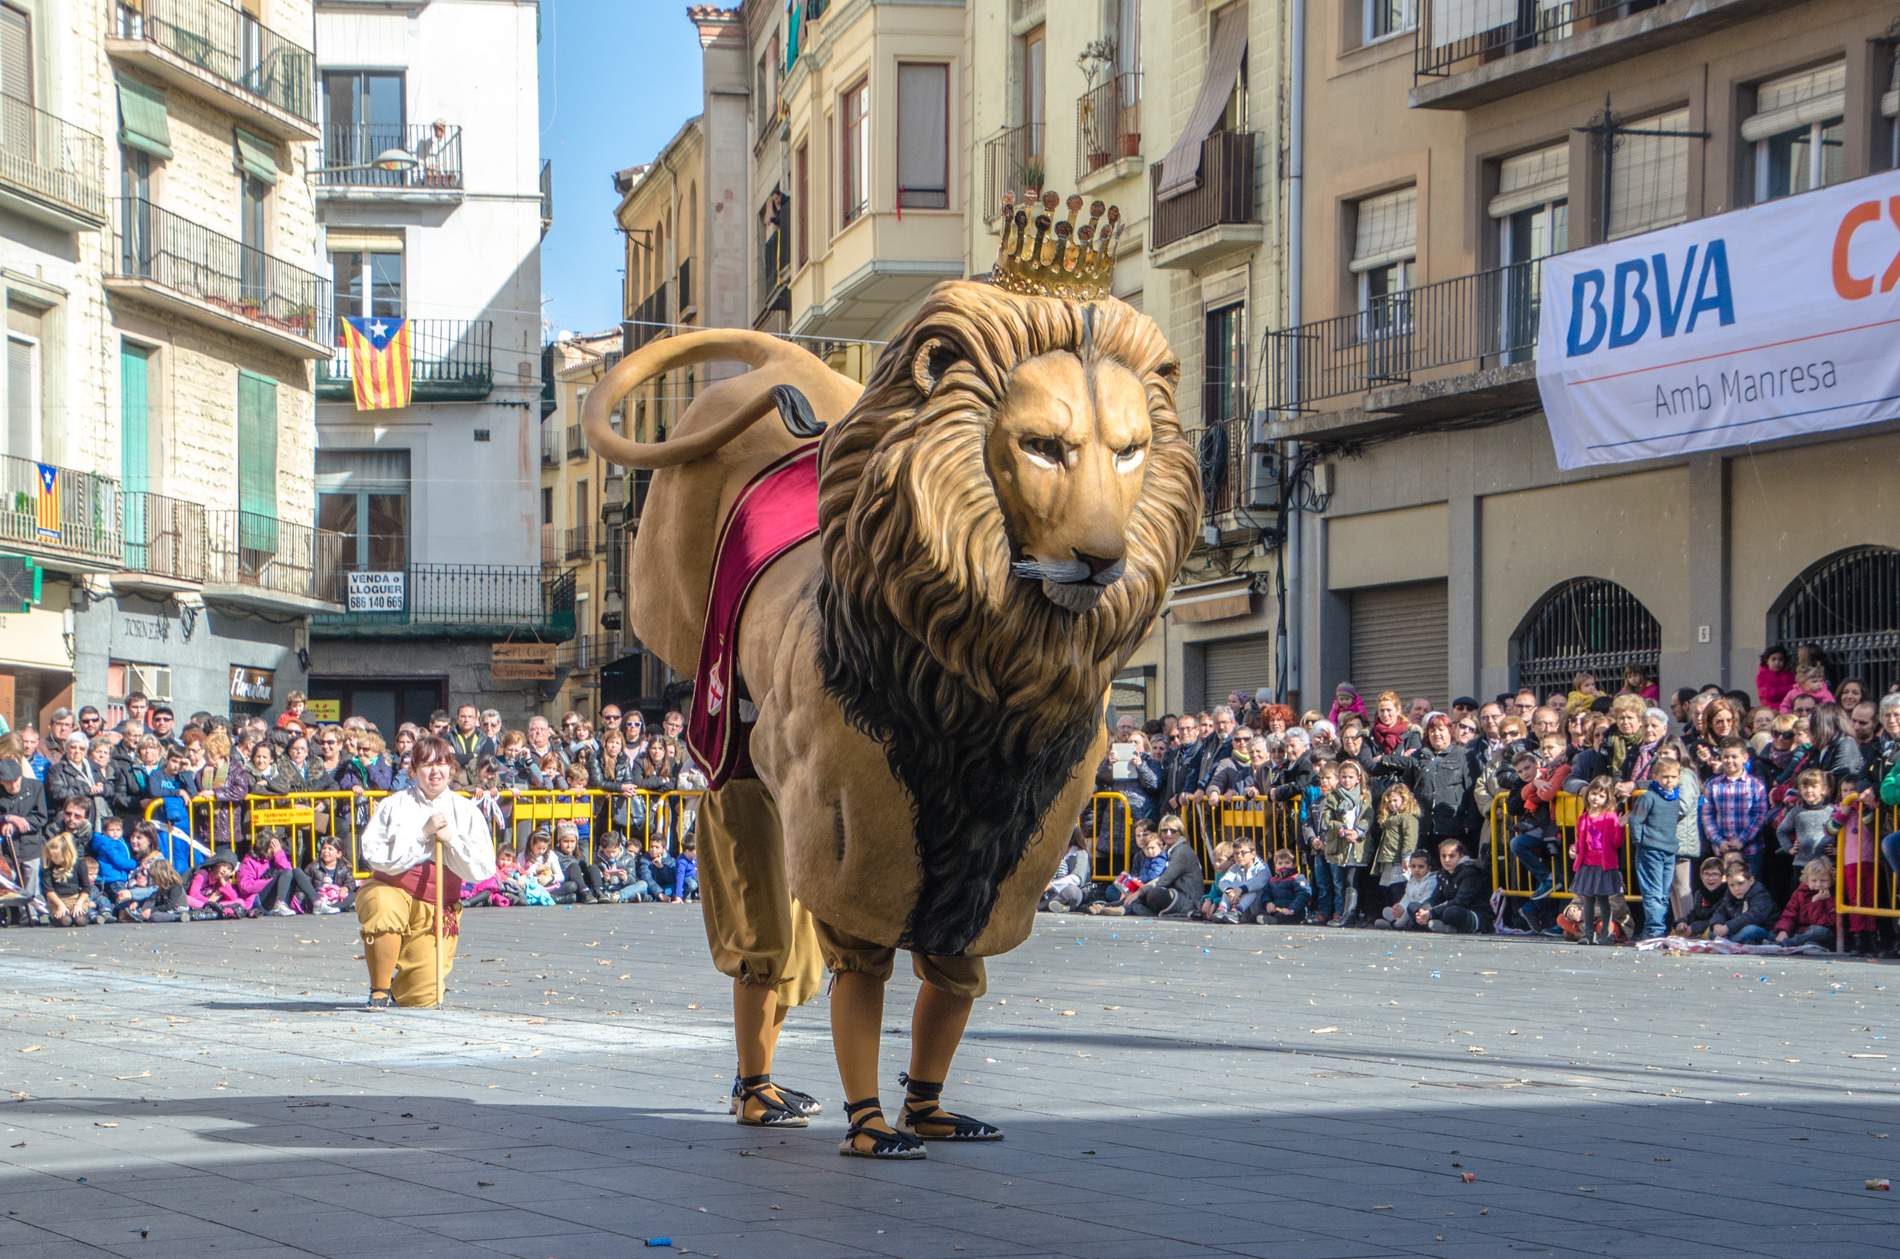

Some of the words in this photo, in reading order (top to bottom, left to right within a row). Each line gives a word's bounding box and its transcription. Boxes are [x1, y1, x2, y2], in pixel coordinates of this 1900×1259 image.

[1566, 238, 1736, 358] BBVA
[1655, 375, 1712, 418] Amb
[1720, 360, 1837, 407] Manresa
[351, 574, 389, 583] VENDA
[350, 585, 402, 594] LLOGUER
[350, 596, 366, 609] 686
[369, 596, 385, 609] 140
[386, 596, 402, 609] 665
